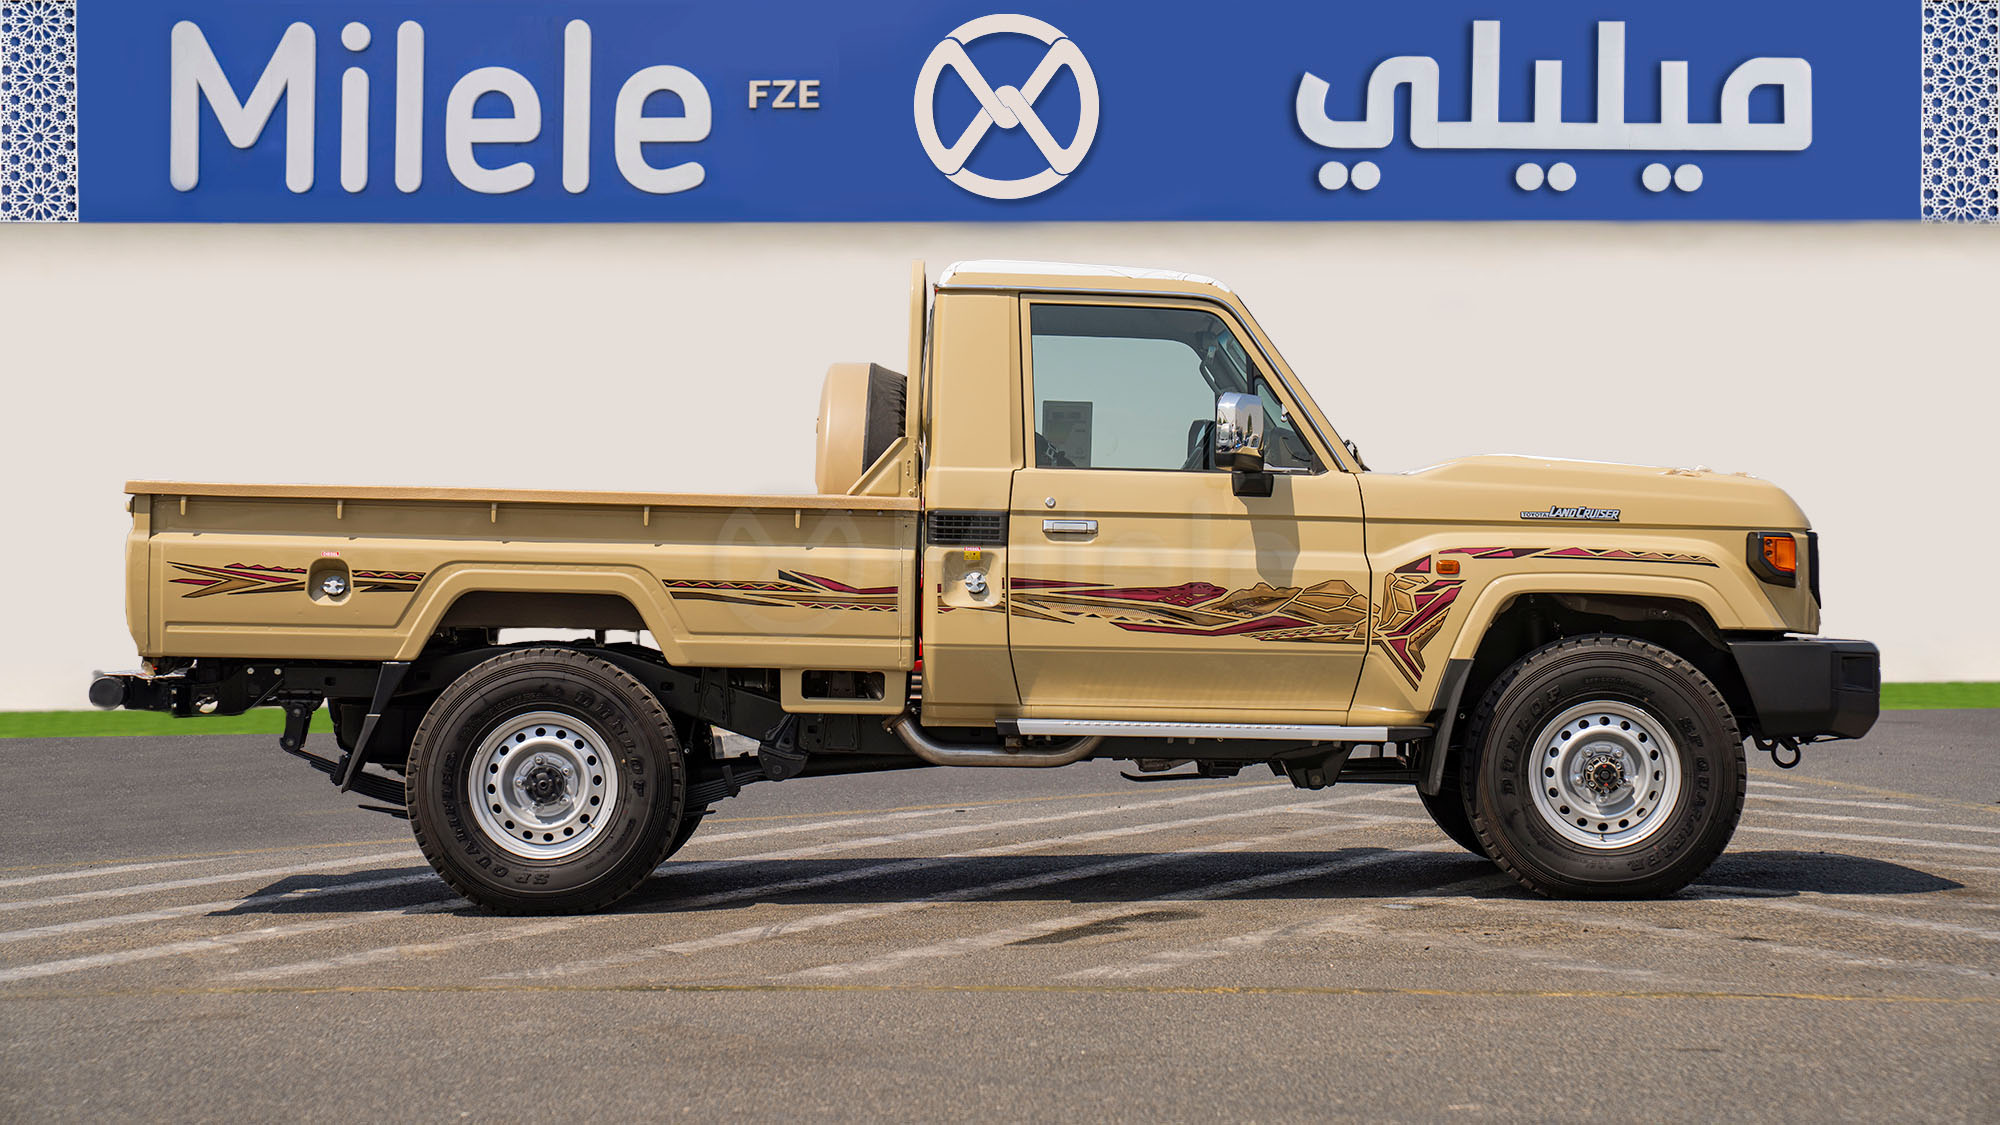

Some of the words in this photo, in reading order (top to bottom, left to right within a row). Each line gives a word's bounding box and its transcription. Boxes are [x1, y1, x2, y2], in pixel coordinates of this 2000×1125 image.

[170, 19, 712, 194] Milele
[748, 79, 820, 110] FZE
[1296, 20, 1813, 192] ميليلي
[574, 689, 647, 798] DUNLOP
[1501, 685, 1562, 796] DUNLOP
